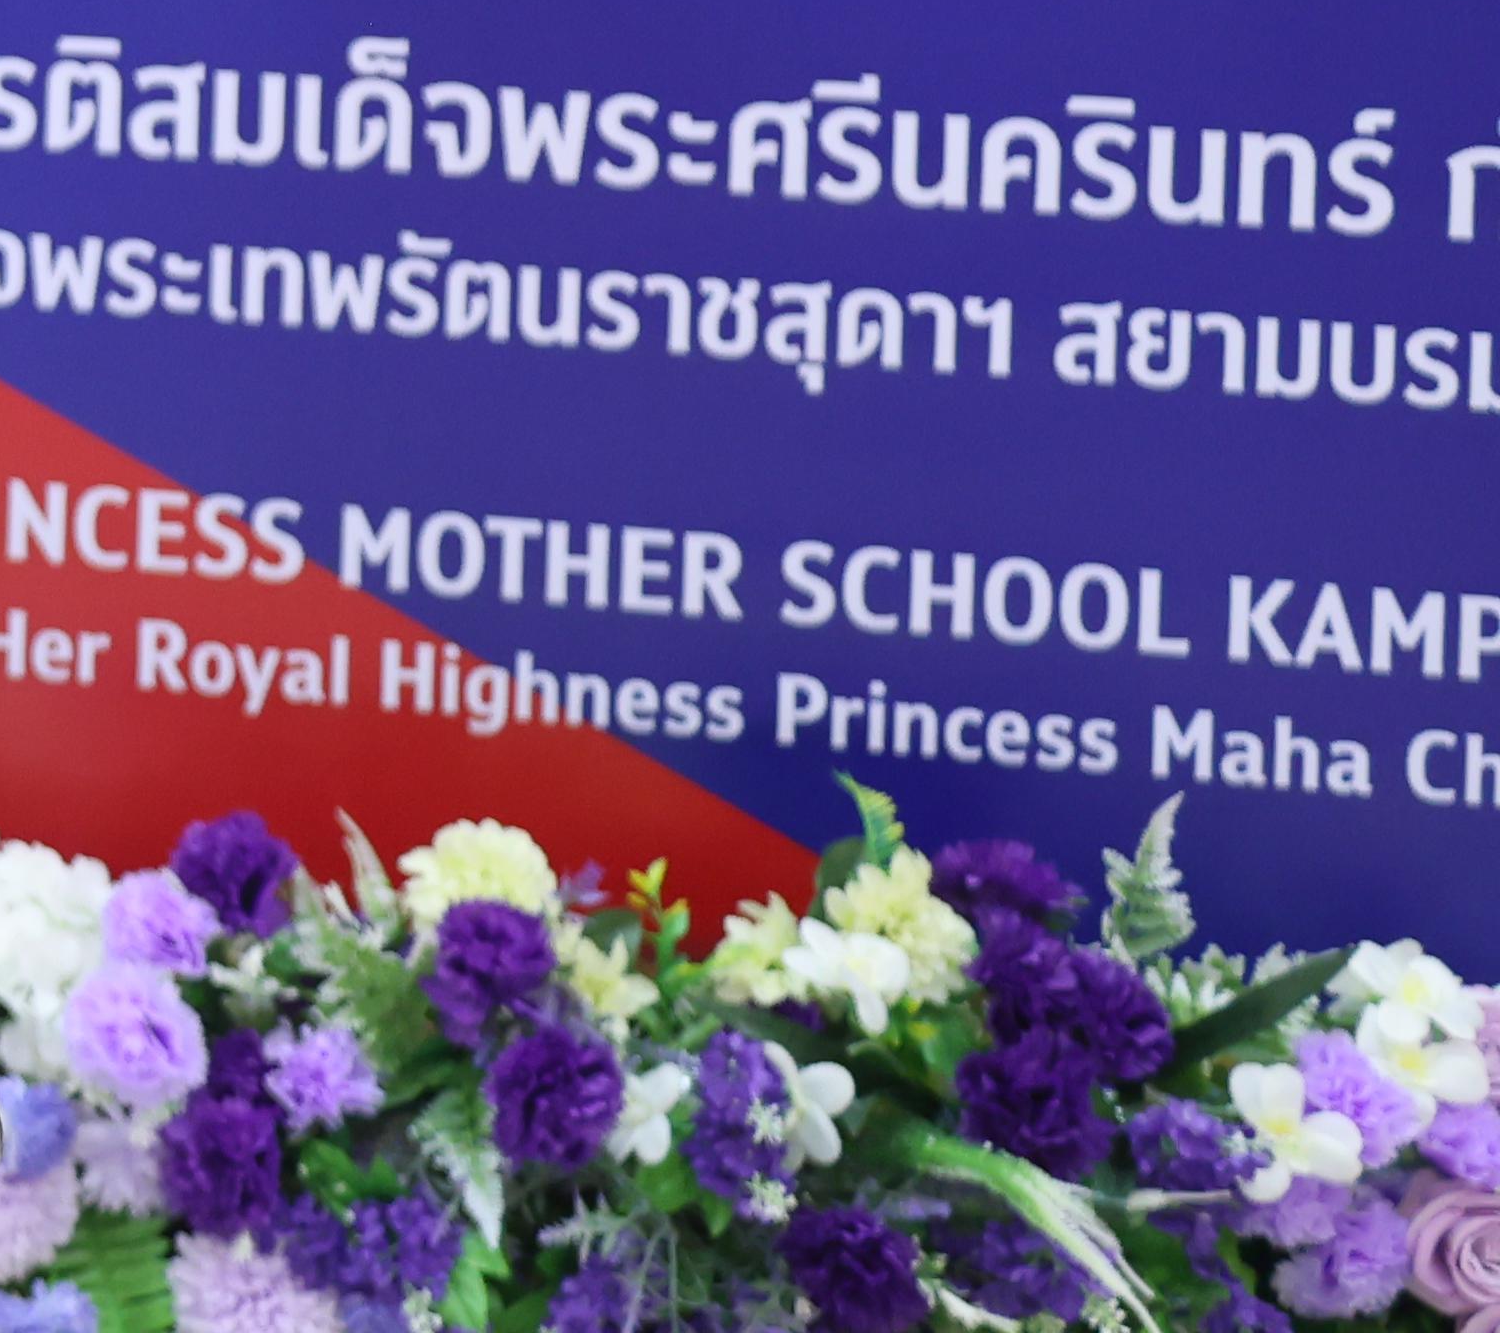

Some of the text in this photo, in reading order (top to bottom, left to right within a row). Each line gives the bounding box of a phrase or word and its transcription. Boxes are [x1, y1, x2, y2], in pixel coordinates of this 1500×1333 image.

[338, 503, 744, 621] MOTHER
[780, 539, 1192, 658] SCHOOL
[136, 617, 352, 715] Royal
[380, 638, 746, 745] Highness
[775, 672, 1120, 774] Princess
[1151, 704, 1375, 798] Maha
